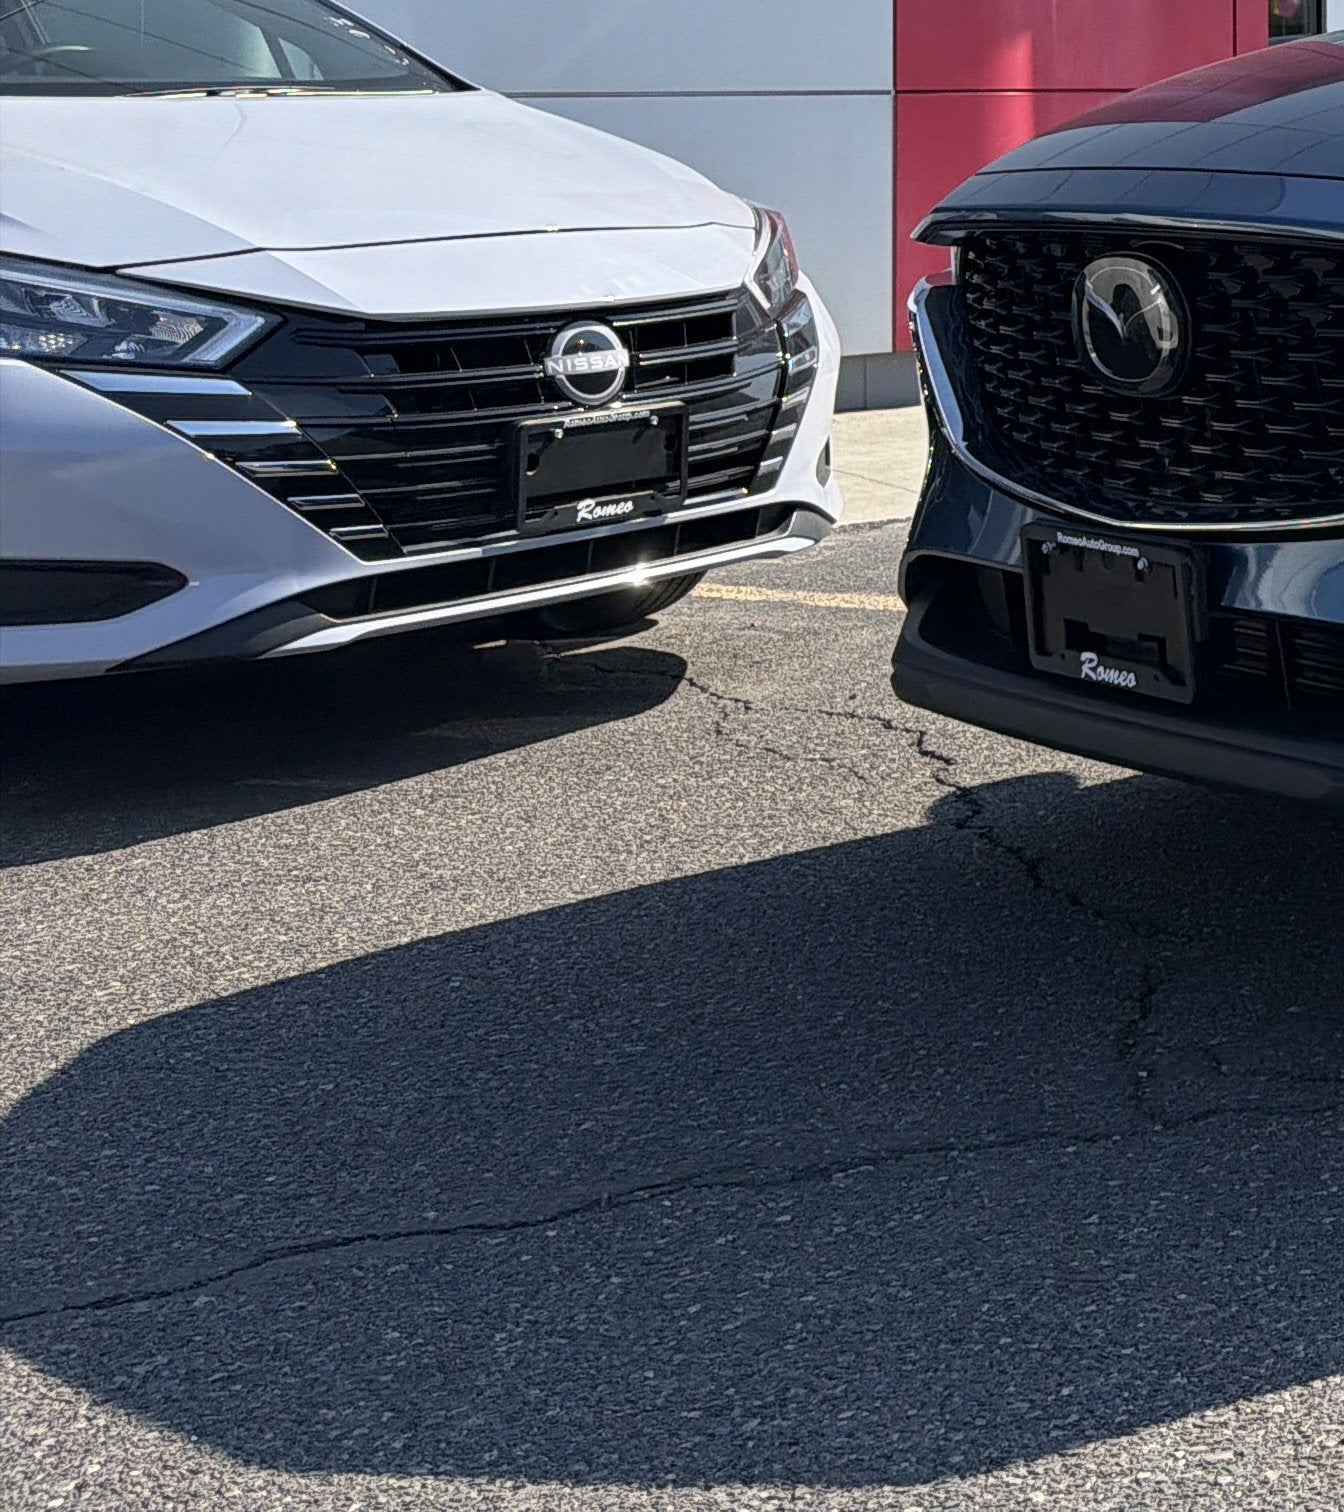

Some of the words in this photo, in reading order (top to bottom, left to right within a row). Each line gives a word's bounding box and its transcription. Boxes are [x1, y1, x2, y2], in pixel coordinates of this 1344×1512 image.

[547, 350, 629, 373] NISSAN
[576, 498, 635, 524] Romeo
[1080, 651, 1137, 688] Romeo
